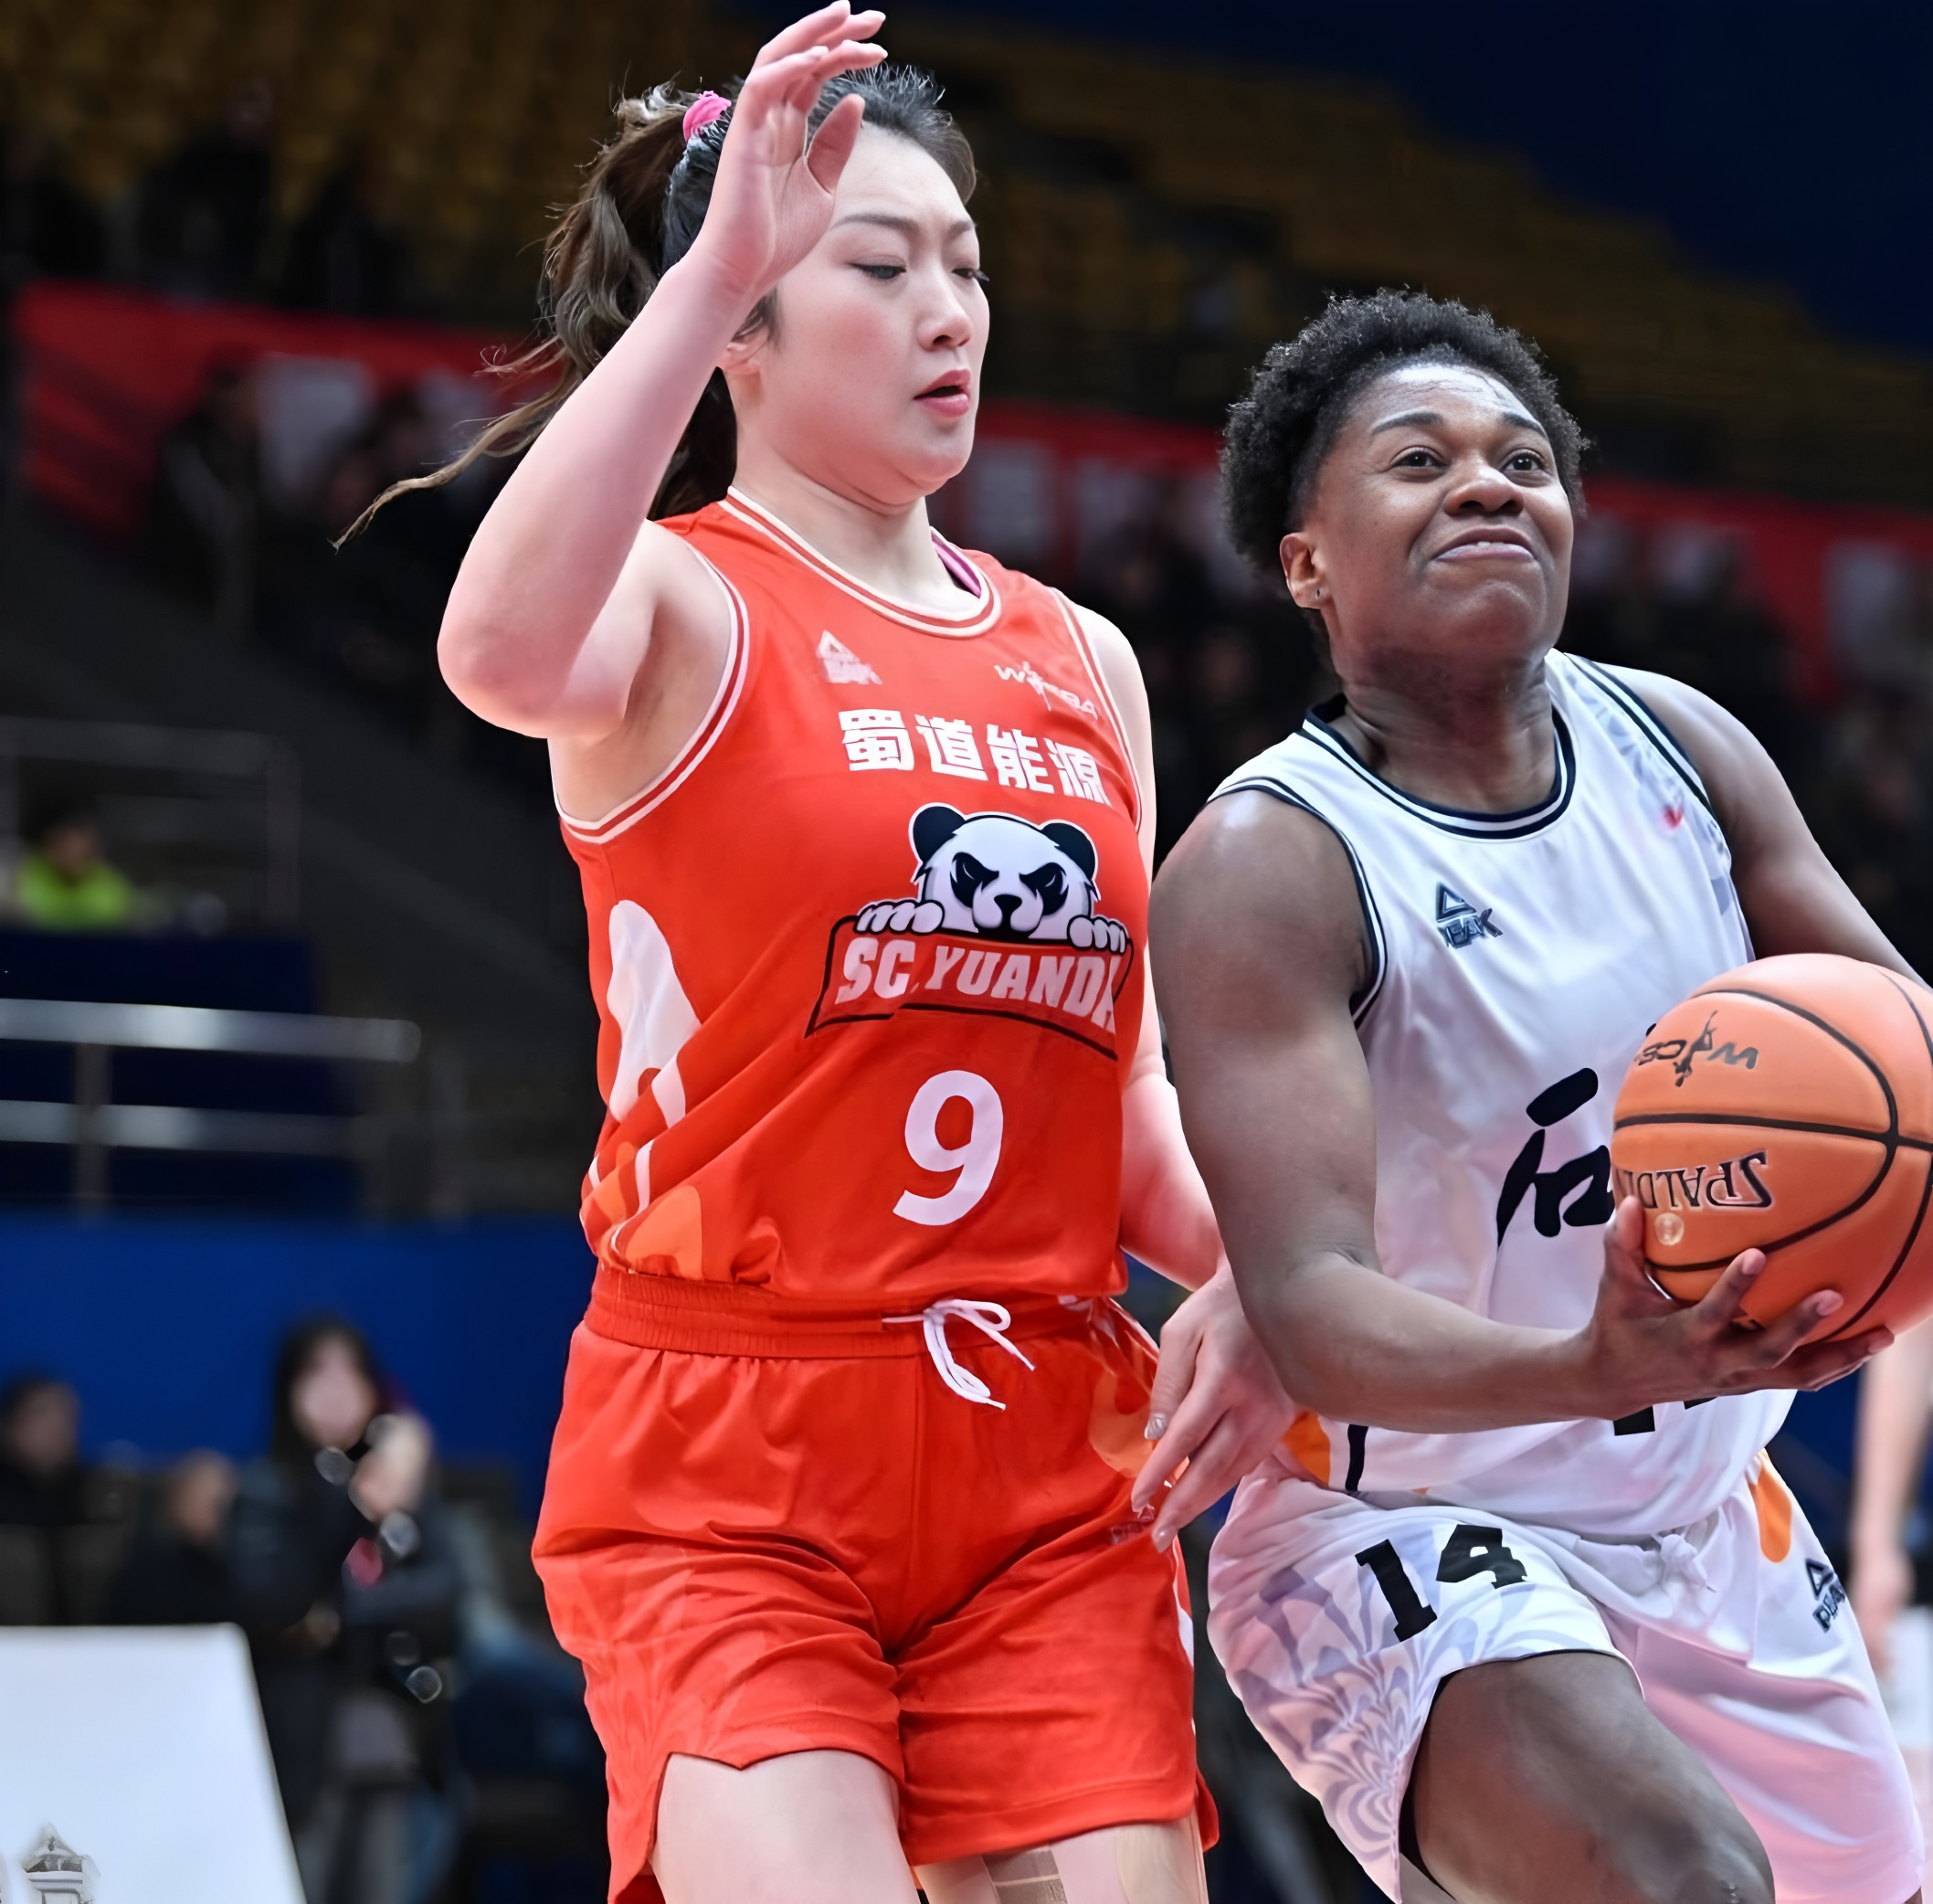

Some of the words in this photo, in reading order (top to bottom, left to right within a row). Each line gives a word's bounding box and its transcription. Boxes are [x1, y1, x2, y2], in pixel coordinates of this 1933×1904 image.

[838, 708, 1112, 808] 蜀道能源
[834, 936, 916, 1005] SC
[892, 1069, 1004, 1226] 9
[1355, 1523, 1528, 1643] 14
